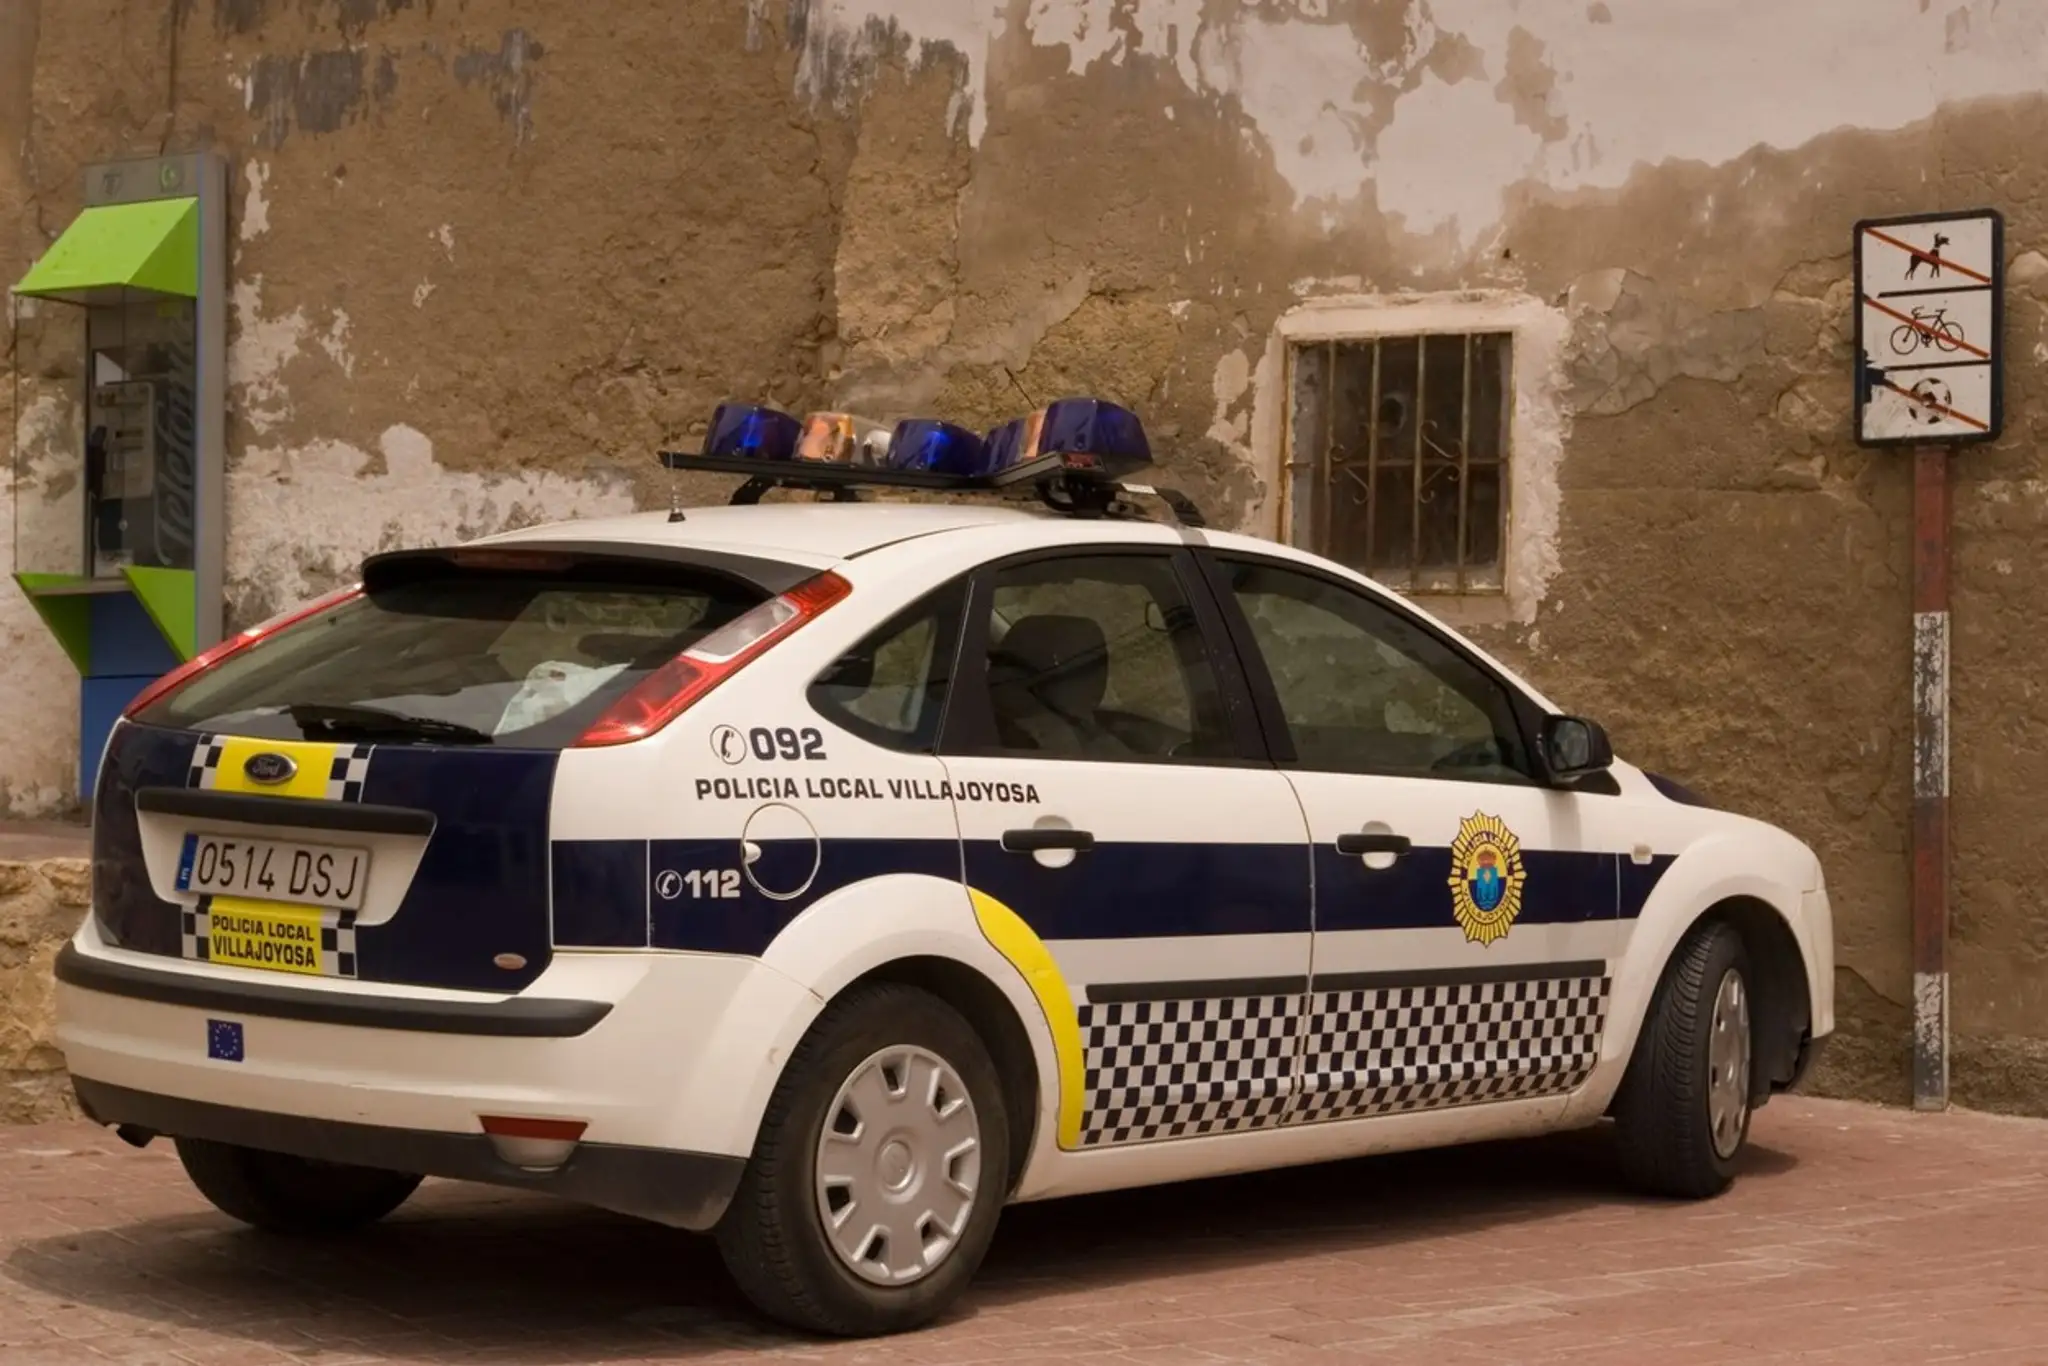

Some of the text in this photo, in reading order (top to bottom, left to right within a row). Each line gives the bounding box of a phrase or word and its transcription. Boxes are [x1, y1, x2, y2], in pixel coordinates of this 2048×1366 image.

[750, 727, 827, 761] 092
[695, 778, 1041, 804] POLICIA LOCAL VILLAJOYOSA
[197, 842, 358, 900] 0514 DSJ
[684, 869, 741, 899] 112
[212, 915, 316, 942] POLICIA LOCAL
[213, 935, 317, 968] VILLAJOYOSA
